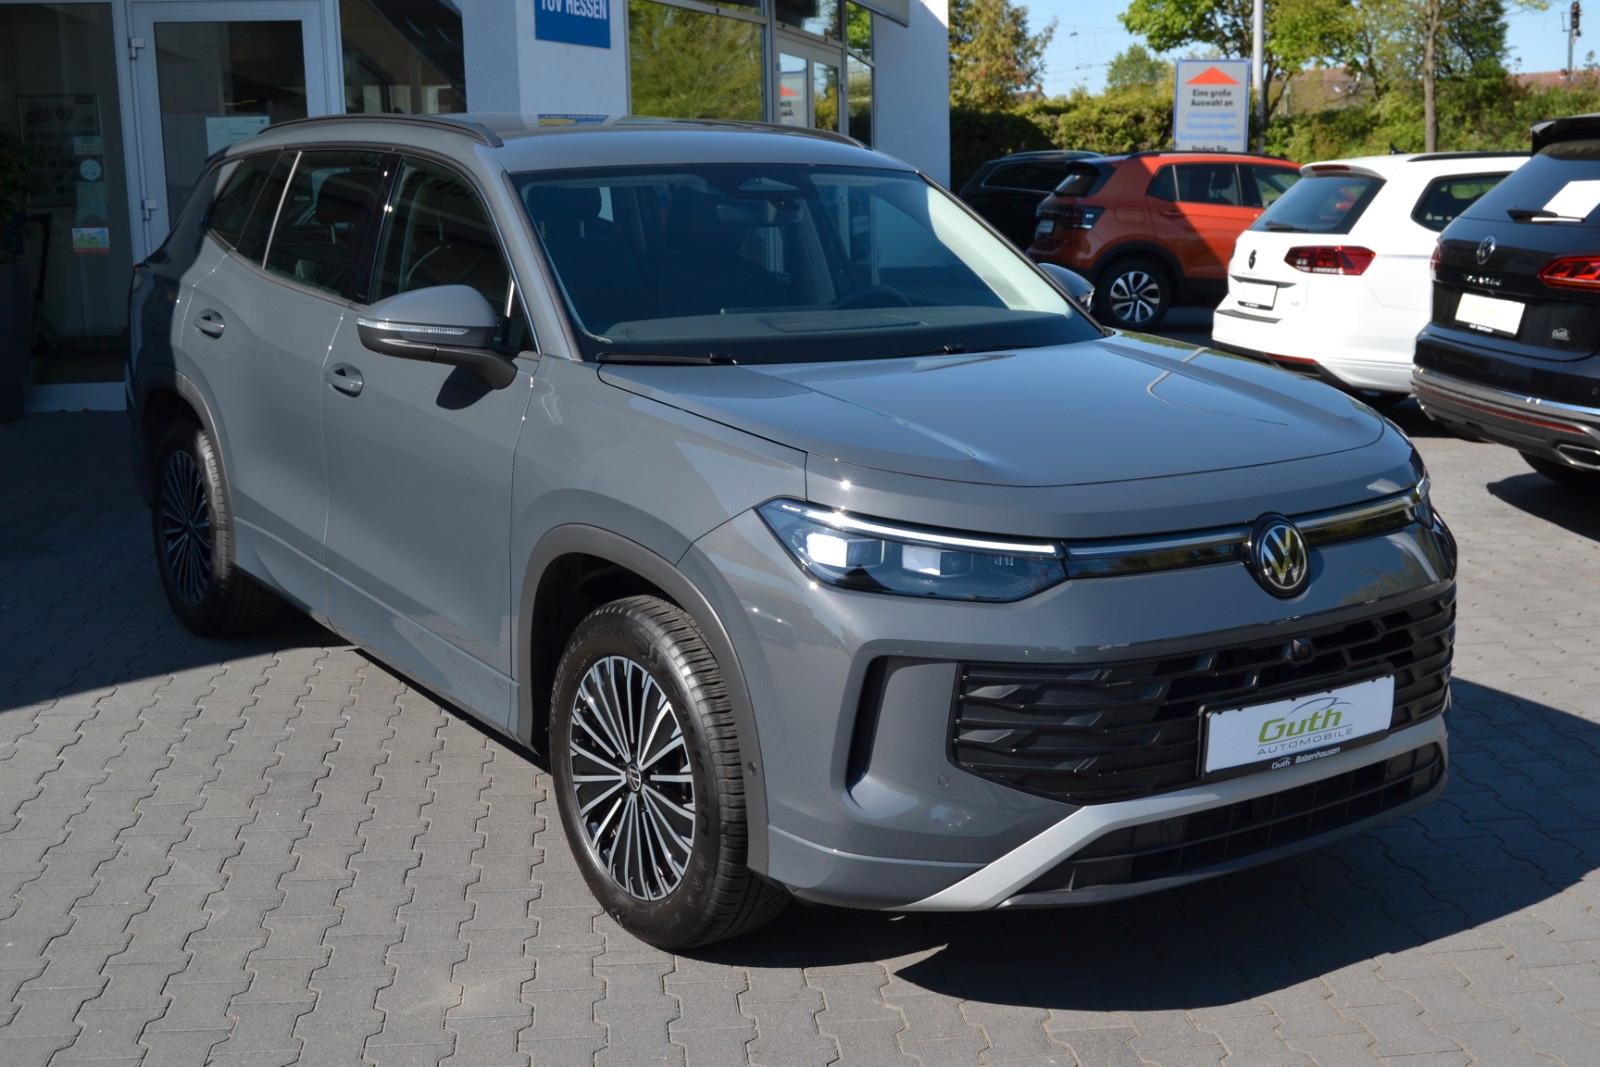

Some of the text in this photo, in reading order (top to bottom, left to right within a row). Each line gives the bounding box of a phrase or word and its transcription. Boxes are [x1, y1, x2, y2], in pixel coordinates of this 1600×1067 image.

[566, 0, 607, 20] HESSEN
[1258, 709, 1343, 744] Guth
[1256, 728, 1354, 756] AUTOMOBILE
